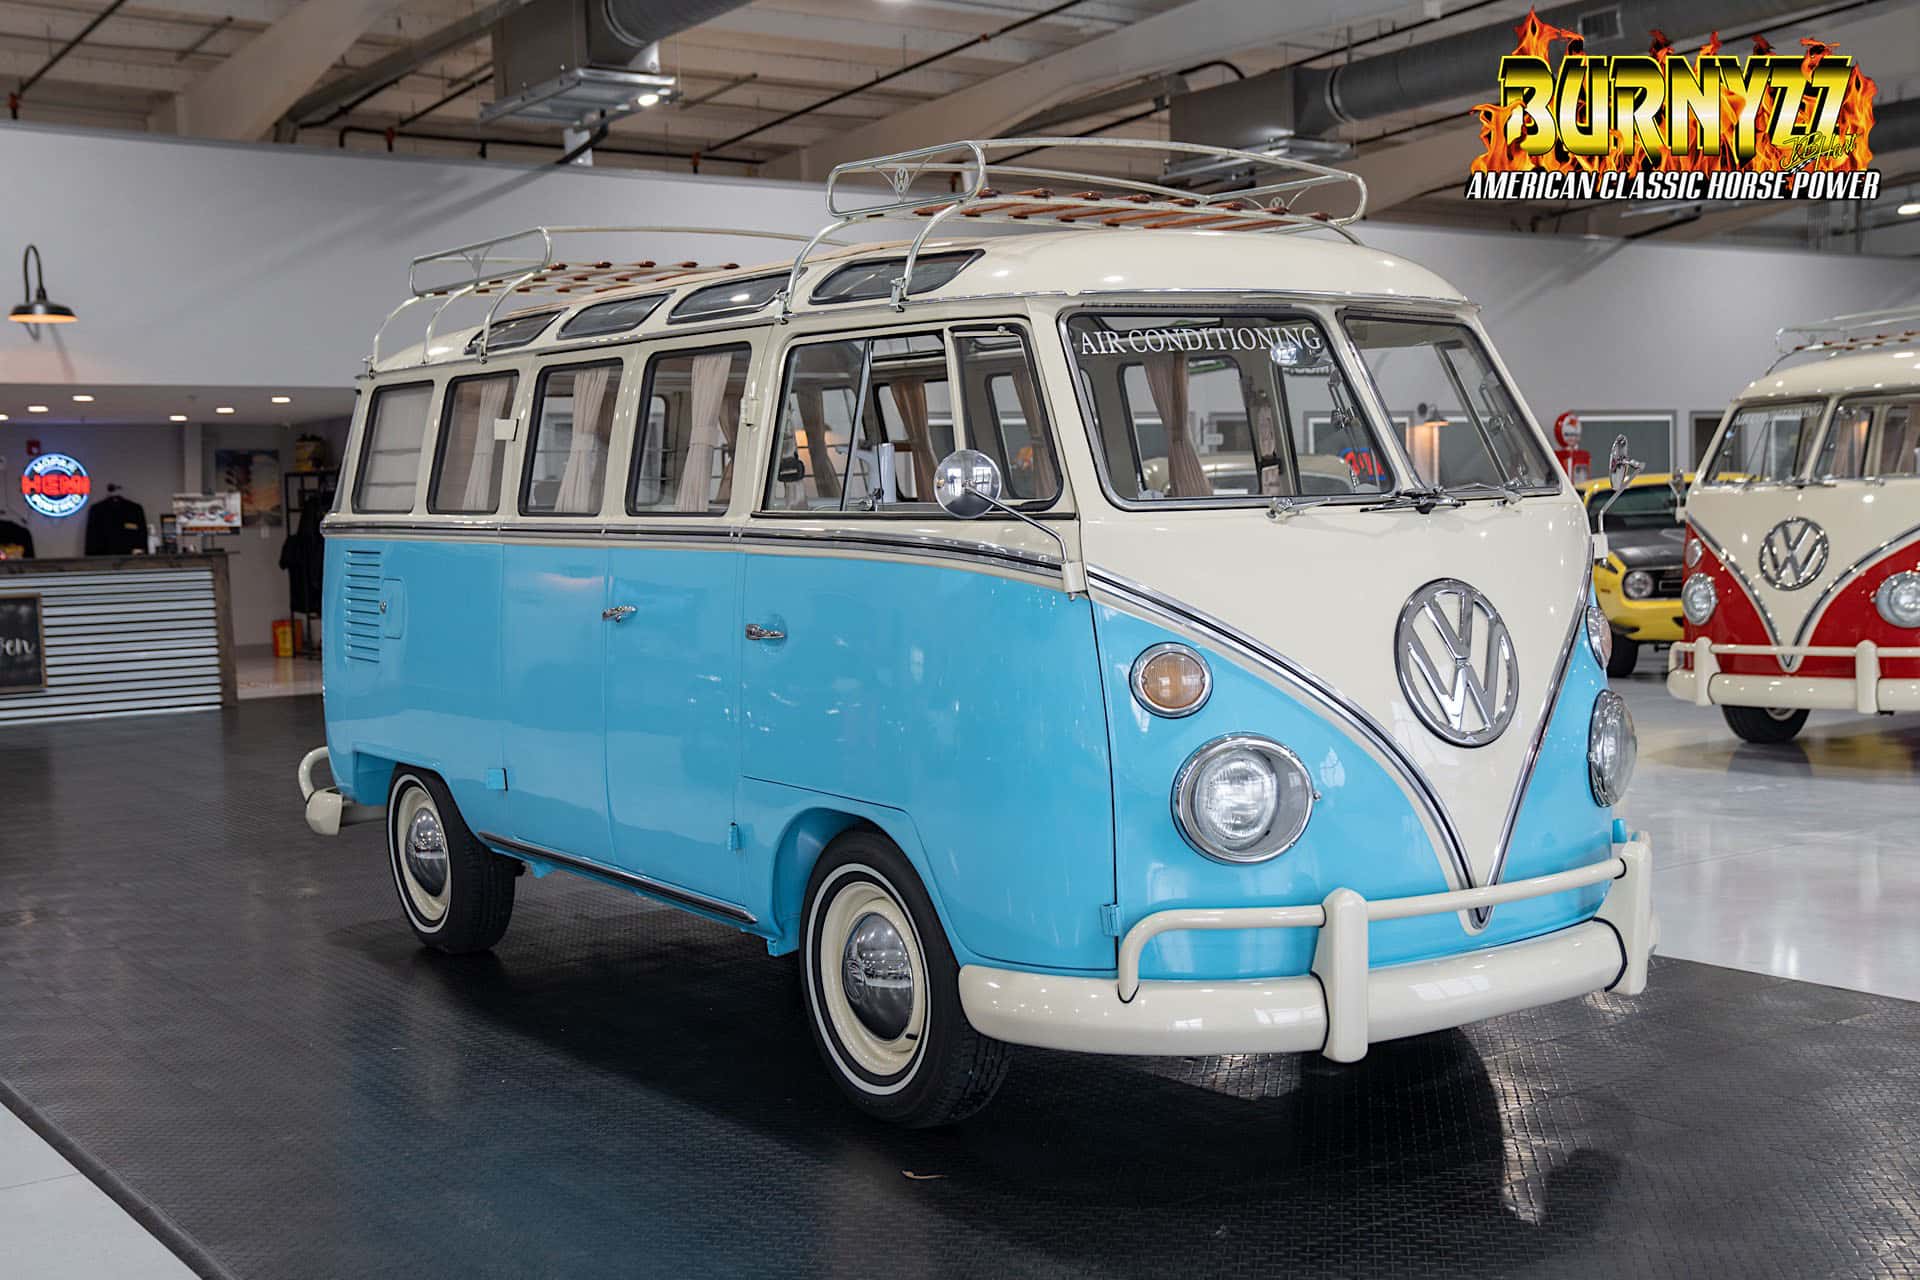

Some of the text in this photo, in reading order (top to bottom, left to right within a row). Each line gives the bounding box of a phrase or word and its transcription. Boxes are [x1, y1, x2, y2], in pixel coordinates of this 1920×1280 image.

[1081, 327, 1322, 355] AIR CONDITIONING
[21, 474, 91, 496] HEMI
[1761, 518, 1829, 589] VW
[1396, 581, 1514, 744] VW
